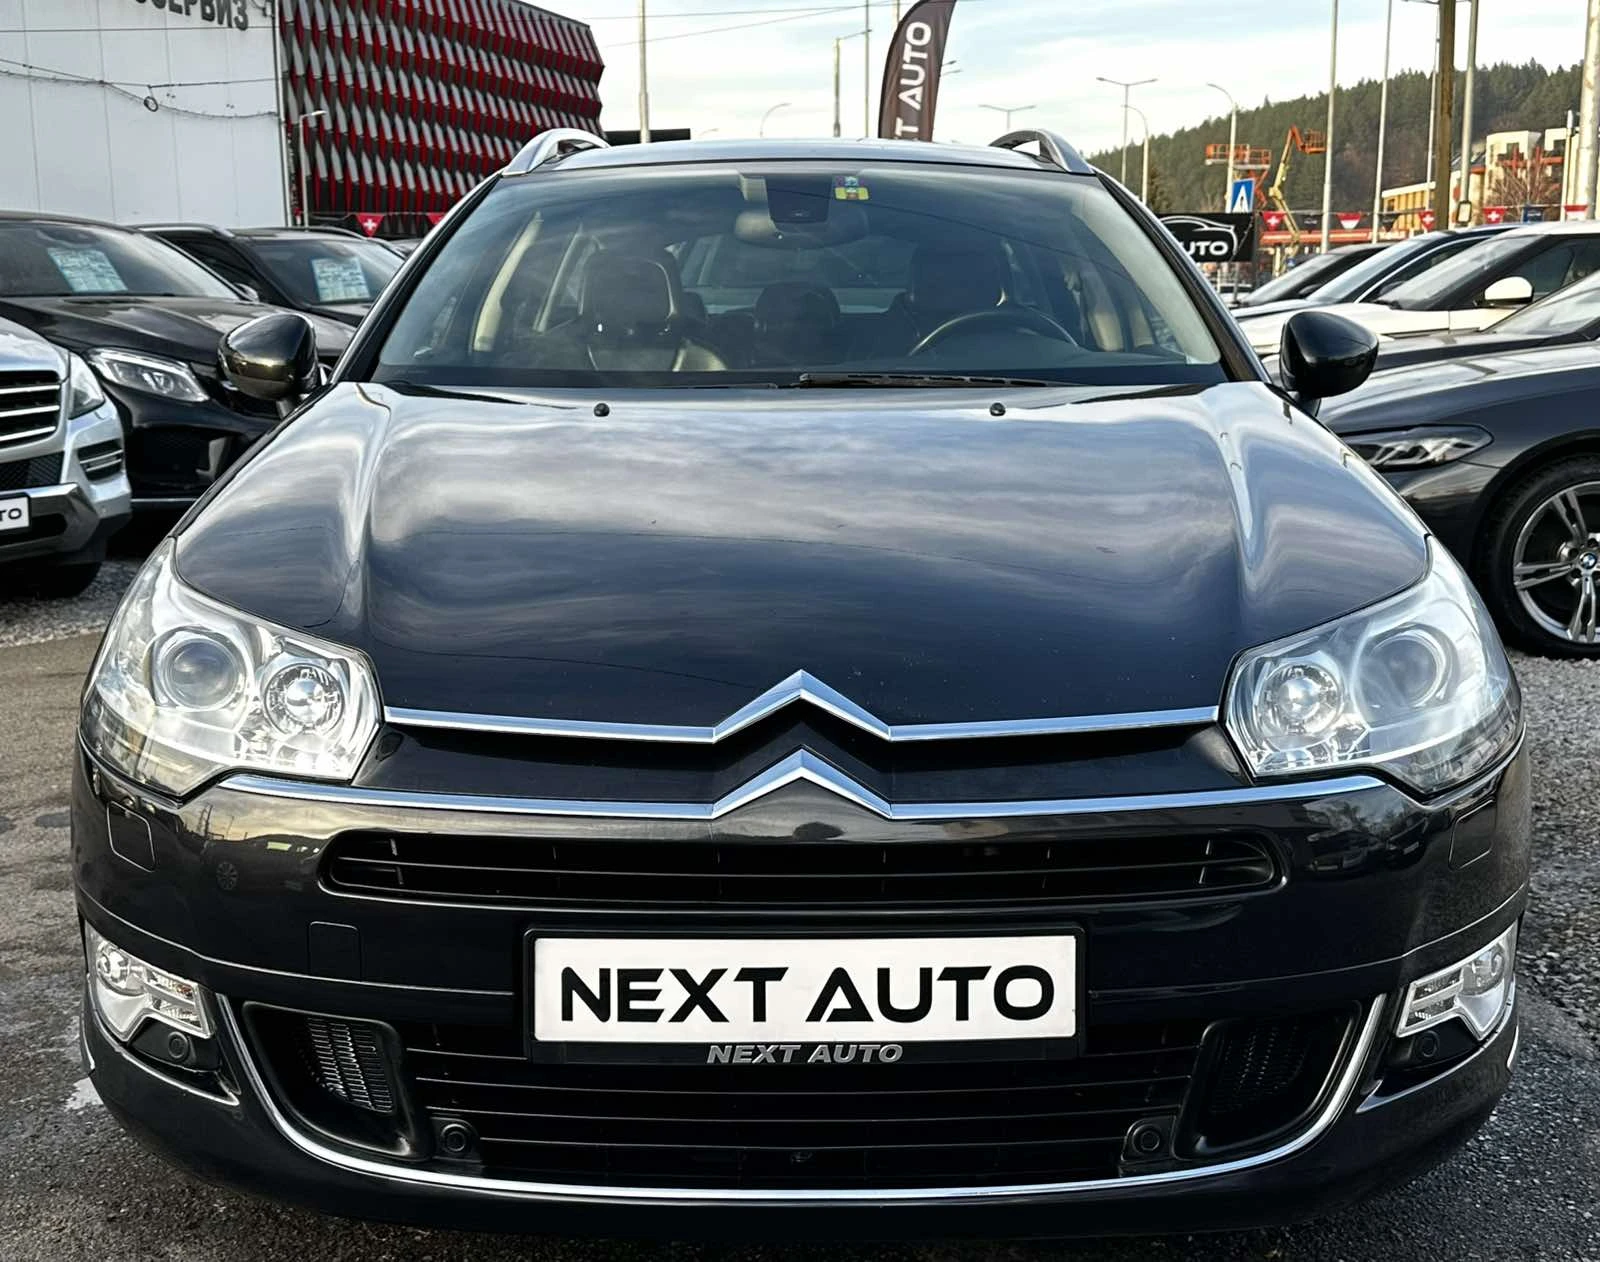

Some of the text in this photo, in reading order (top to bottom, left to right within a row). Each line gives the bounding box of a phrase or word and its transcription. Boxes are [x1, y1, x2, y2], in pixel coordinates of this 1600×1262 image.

[898, 21, 932, 111] AUTO
[561, 965, 1055, 1024] NEXT AUTO
[707, 1044, 903, 1064] NEXT AUTO
